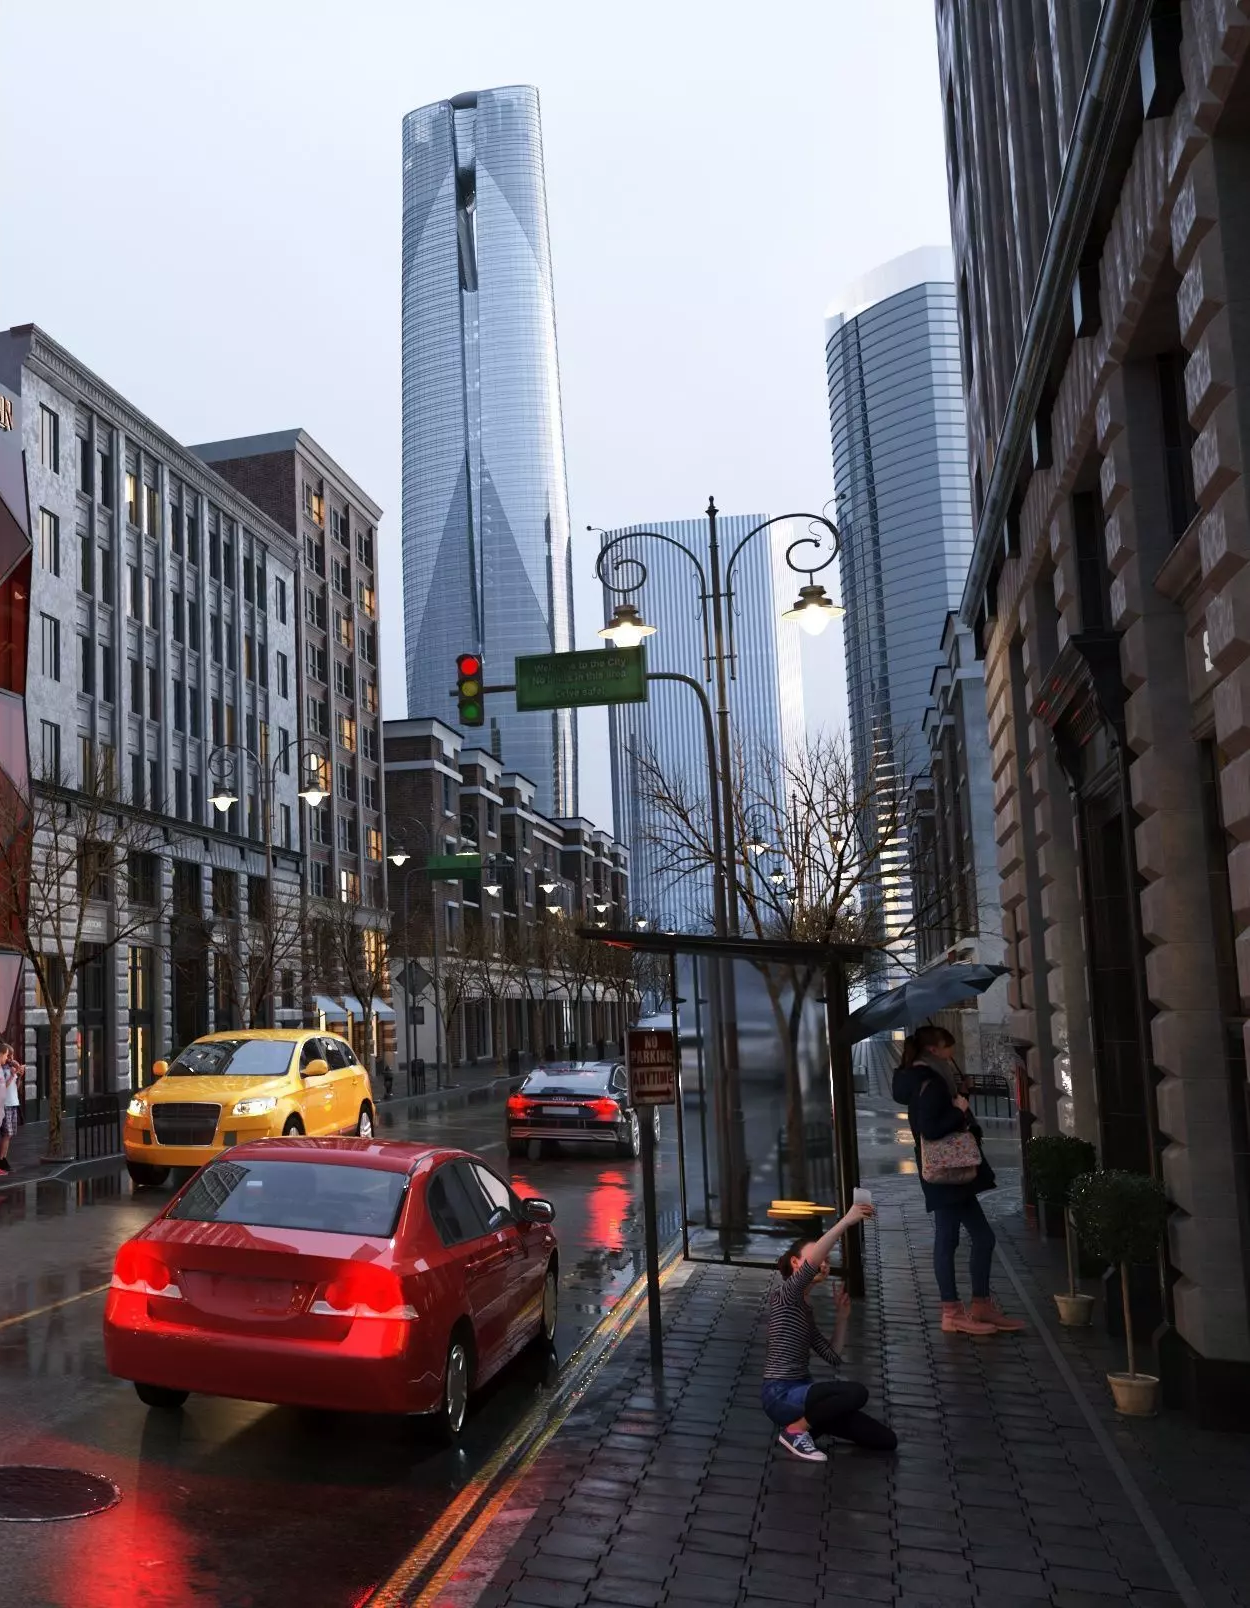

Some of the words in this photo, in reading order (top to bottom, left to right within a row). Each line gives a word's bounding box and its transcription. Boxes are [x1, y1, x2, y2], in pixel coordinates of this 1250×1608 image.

[535, 662, 576, 674] Wele
[578, 661, 588, 669] to
[644, 1035, 658, 1049] NO
[630, 1050, 673, 1064] PARKING
[632, 1070, 675, 1085] ANYTIME
